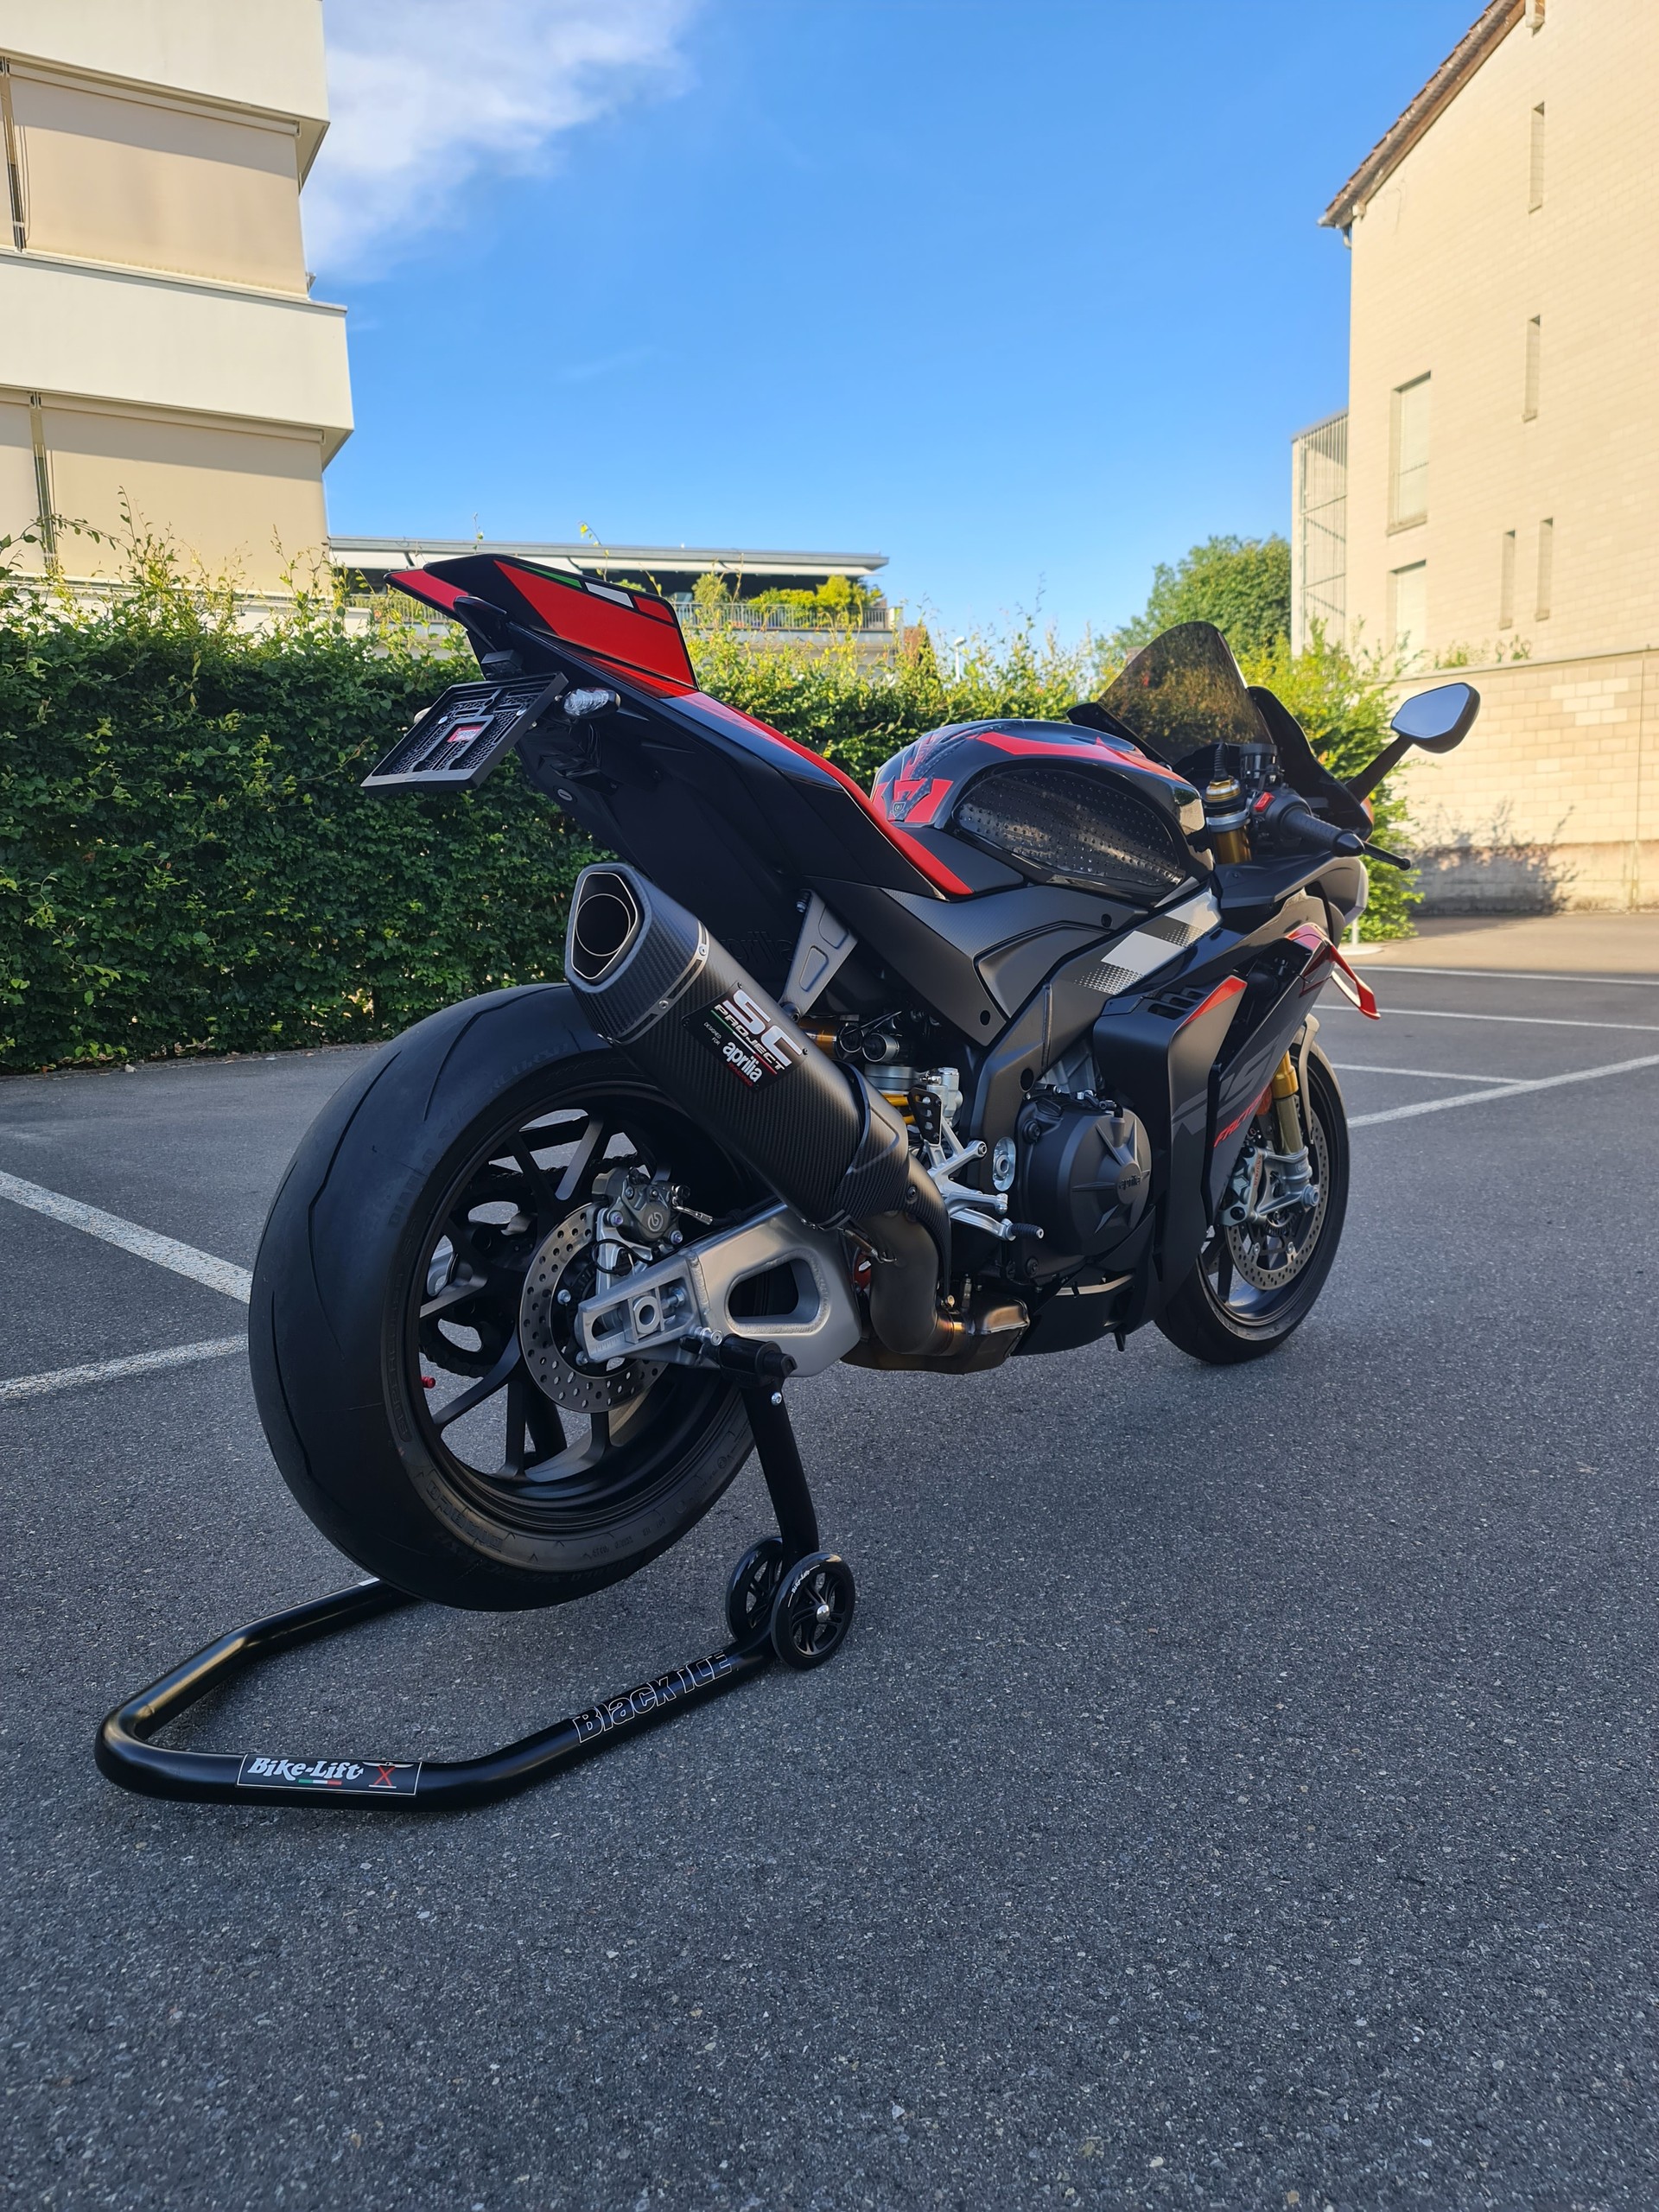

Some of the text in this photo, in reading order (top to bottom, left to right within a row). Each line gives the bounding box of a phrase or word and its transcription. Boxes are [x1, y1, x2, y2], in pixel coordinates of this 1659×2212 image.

[718, 927, 793, 963] prilia
[703, 1021, 722, 1039] DESIGNED
[711, 1037, 721, 1046] FOR
[714, 1004, 785, 1070] PROJECT
[722, 989, 803, 1067] SC
[722, 1041, 763, 1083] aprilia
[572, 1675, 677, 1744] Black
[247, 1757, 363, 1782] Bike-Lift
